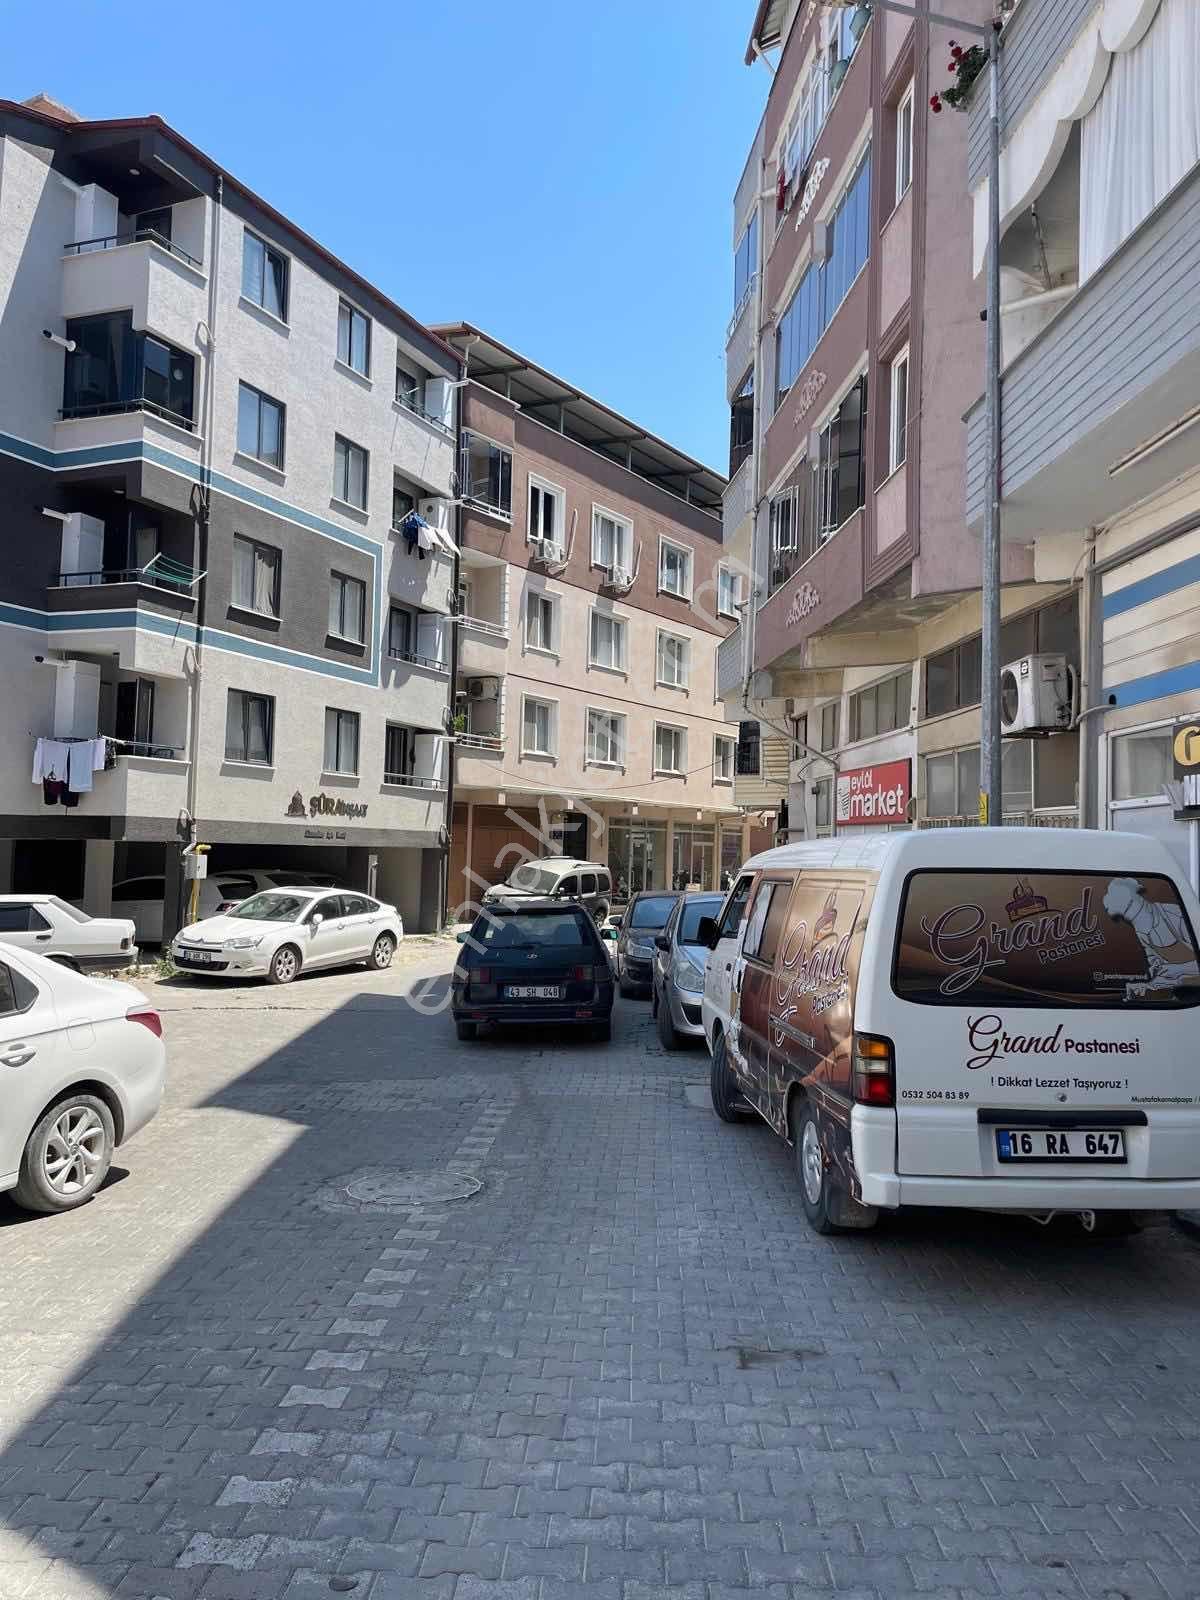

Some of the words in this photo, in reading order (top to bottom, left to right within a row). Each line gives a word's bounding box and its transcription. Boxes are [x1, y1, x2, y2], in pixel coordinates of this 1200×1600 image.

[851, 783, 904, 816] market
[921, 886, 1097, 995] Grand
[1036, 930, 1106, 963] Pastanesi
[510, 987, 520, 997] 43
[526, 987, 537, 997] SH
[966, 1014, 1064, 1070] Grand
[1064, 1038, 1140, 1054] Pastanesi
[902, 1090, 923, 1098] 0532
[926, 1090, 942, 1099] 504
[945, 1091, 956, 1099] 83
[959, 1091, 970, 1099] 89
[997, 1076, 1032, 1087] Dikkat
[1035, 1077, 1069, 1088] Lezzet
[1073, 1078, 1122, 1090] Taşıyoruz
[1009, 1133, 1033, 1154] 16
[1045, 1133, 1070, 1154] RA
[1085, 1133, 1120, 1154] 647
